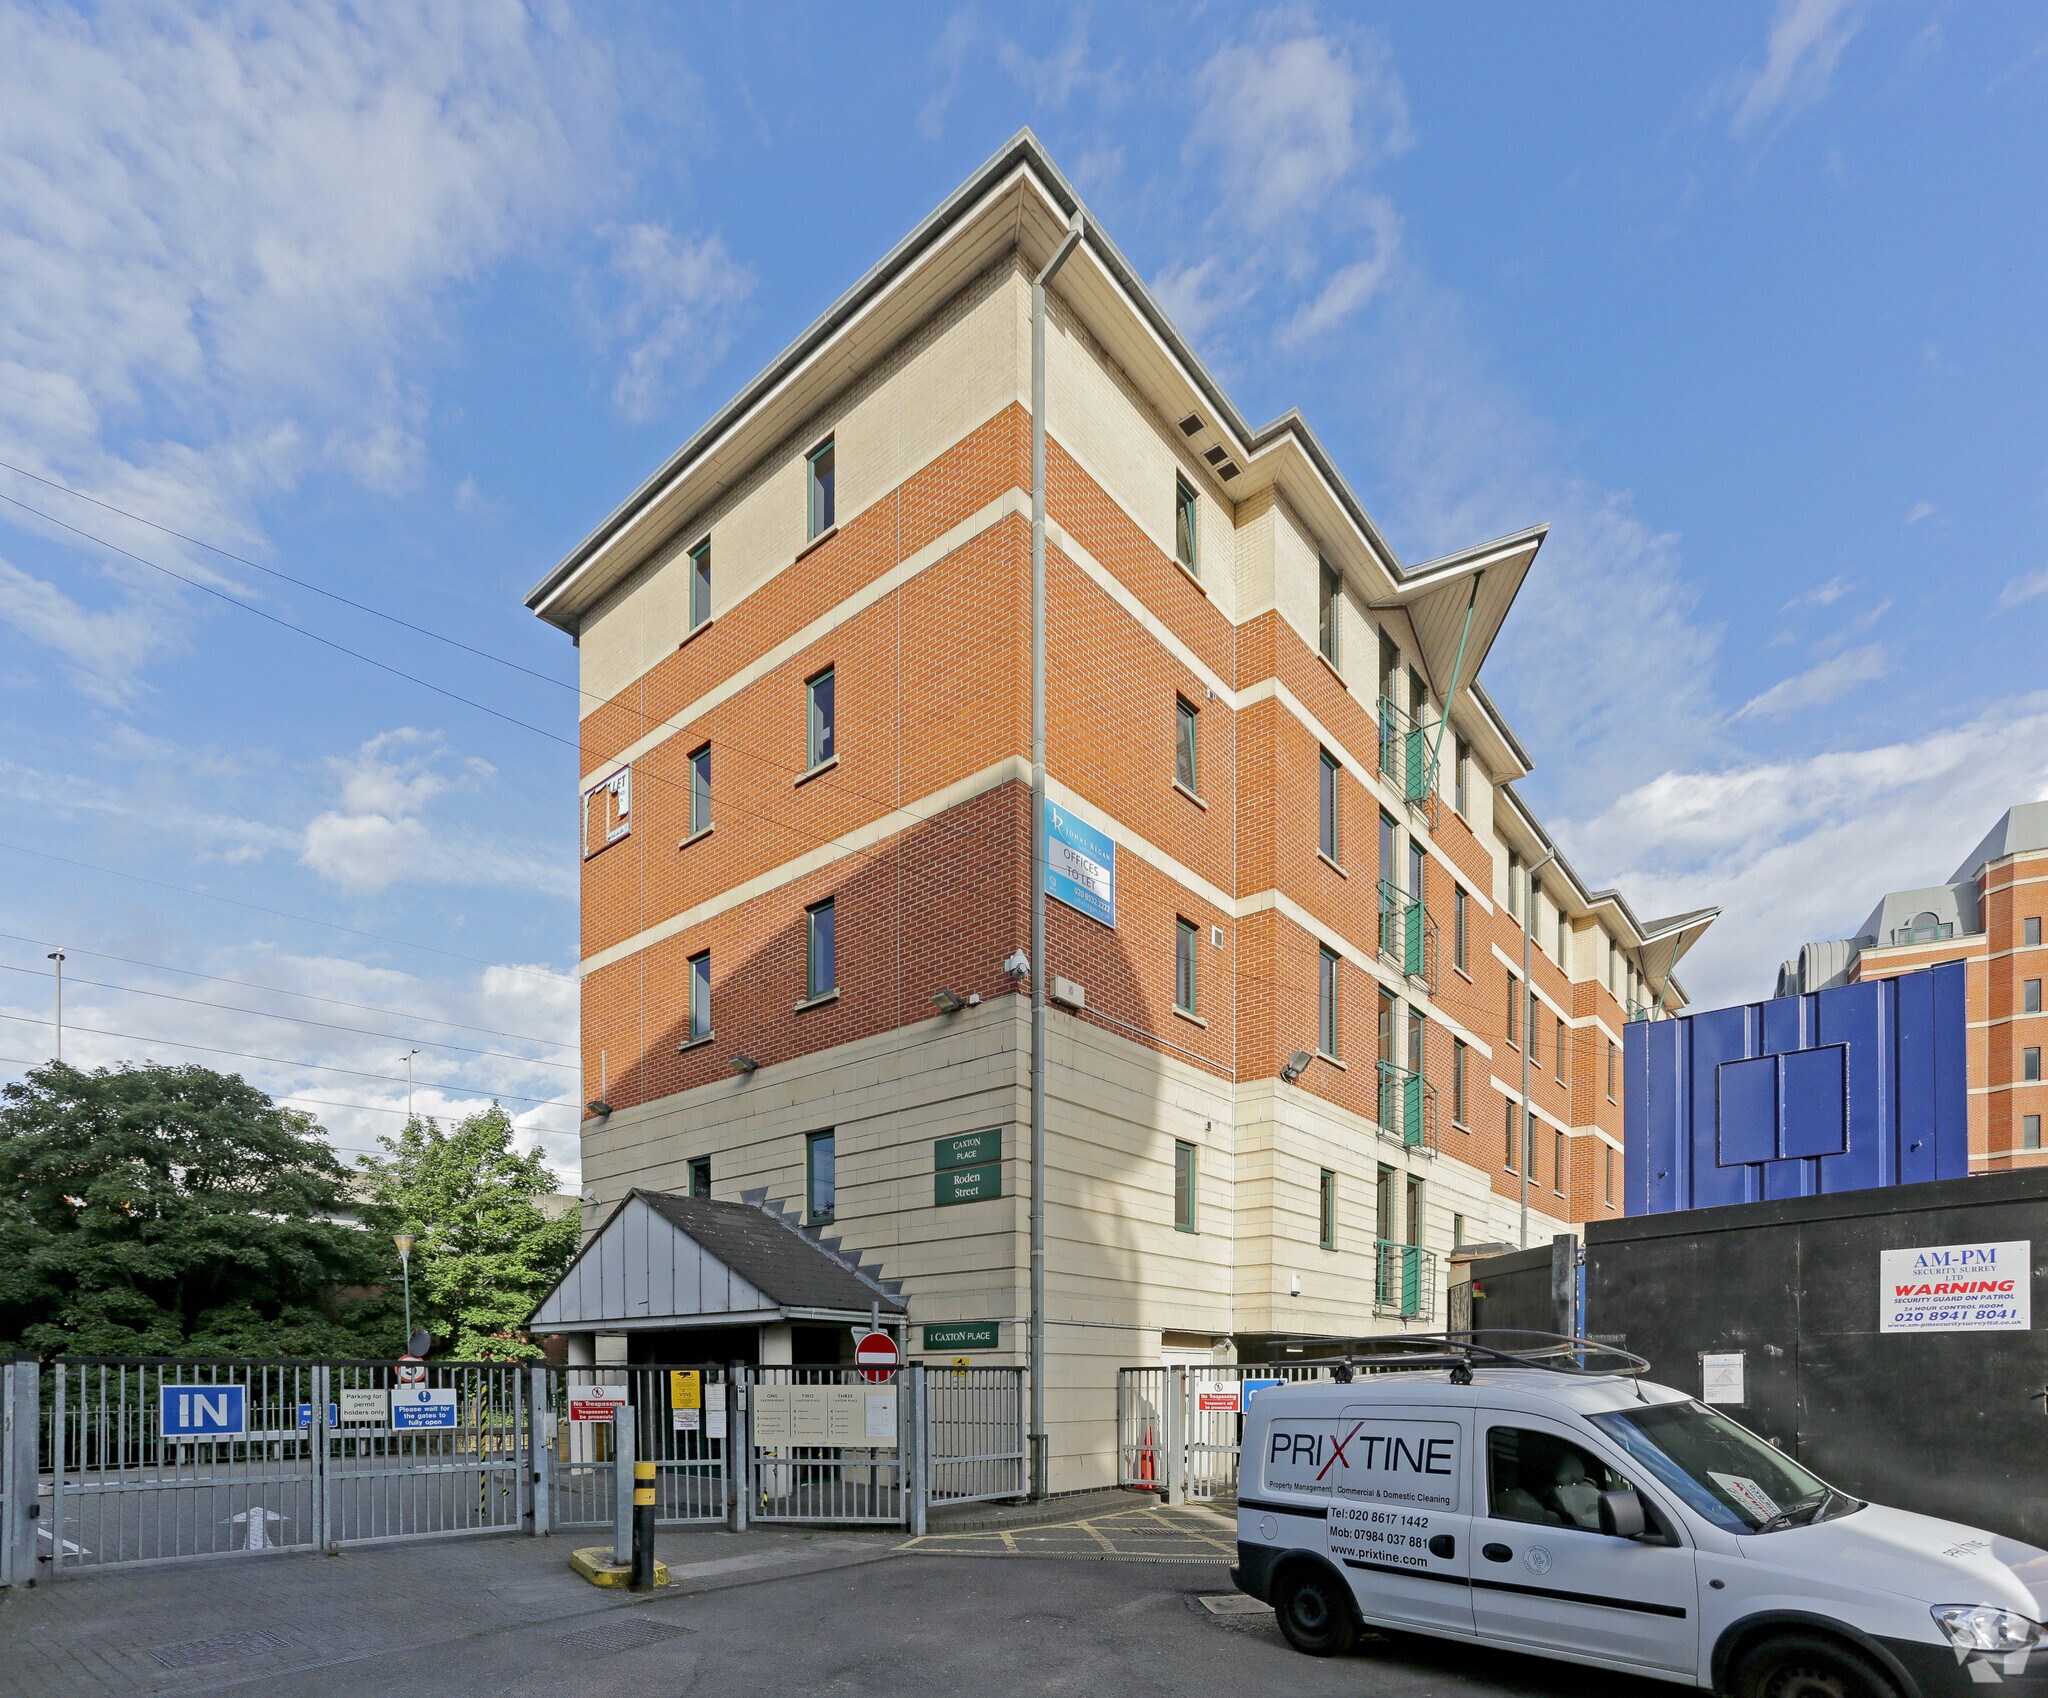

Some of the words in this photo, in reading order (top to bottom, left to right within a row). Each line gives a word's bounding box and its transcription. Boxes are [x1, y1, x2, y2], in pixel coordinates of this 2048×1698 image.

[1065, 828, 1087, 846] JOHAL
[1090, 842, 1110, 861] REGAN
[1063, 848, 1099, 877] OFFICES
[1066, 865, 1079, 880] TO
[1081, 874, 1096, 891] LET
[953, 1138, 981, 1150] CAXTON
[956, 1150, 977, 1160] PLACE
[954, 1173, 980, 1185] Roden
[954, 1186, 979, 1198] Street
[1914, 1248, 1997, 1267] AM-PM
[1912, 1267, 1957, 1276] SECURITY
[1960, 1265, 1997, 1273] SURREY
[1895, 1280, 2015, 1296] WARNING
[1895, 1312, 1923, 1321] 020
[1929, 1311, 1968, 1320] 8941
[1975, 1309, 2016, 1319] 8041
[1888, 1320, 2022, 1328] www.am-pmsecuritysurreyltd.co.uk
[935, 1331, 966, 1342] CAXTON
[967, 1331, 990, 1340] PLACE
[179, 1393, 228, 1427] IN
[1270, 1421, 1454, 1481] PRIXTINE
[1269, 1481, 1293, 1491] Property
[1294, 1482, 1332, 1493] Management
[1337, 1486, 1375, 1497] Commercial
[1383, 1490, 1416, 1501] Domestic
[1417, 1493, 1451, 1505] Cleaning
[1331, 1507, 1348, 1519] Tel:
[1349, 1509, 1368, 1521] 020
[1371, 1511, 1397, 1525] 8617
[1401, 1515, 1429, 1529] 1442
[1330, 1526, 1352, 1539] Mob:
[1354, 1528, 1384, 1543] 07984
[1387, 1532, 1406, 1545] 037
[1408, 1536, 1428, 1549] 881
[1330, 1544, 1428, 1567] www.prixtine.com
